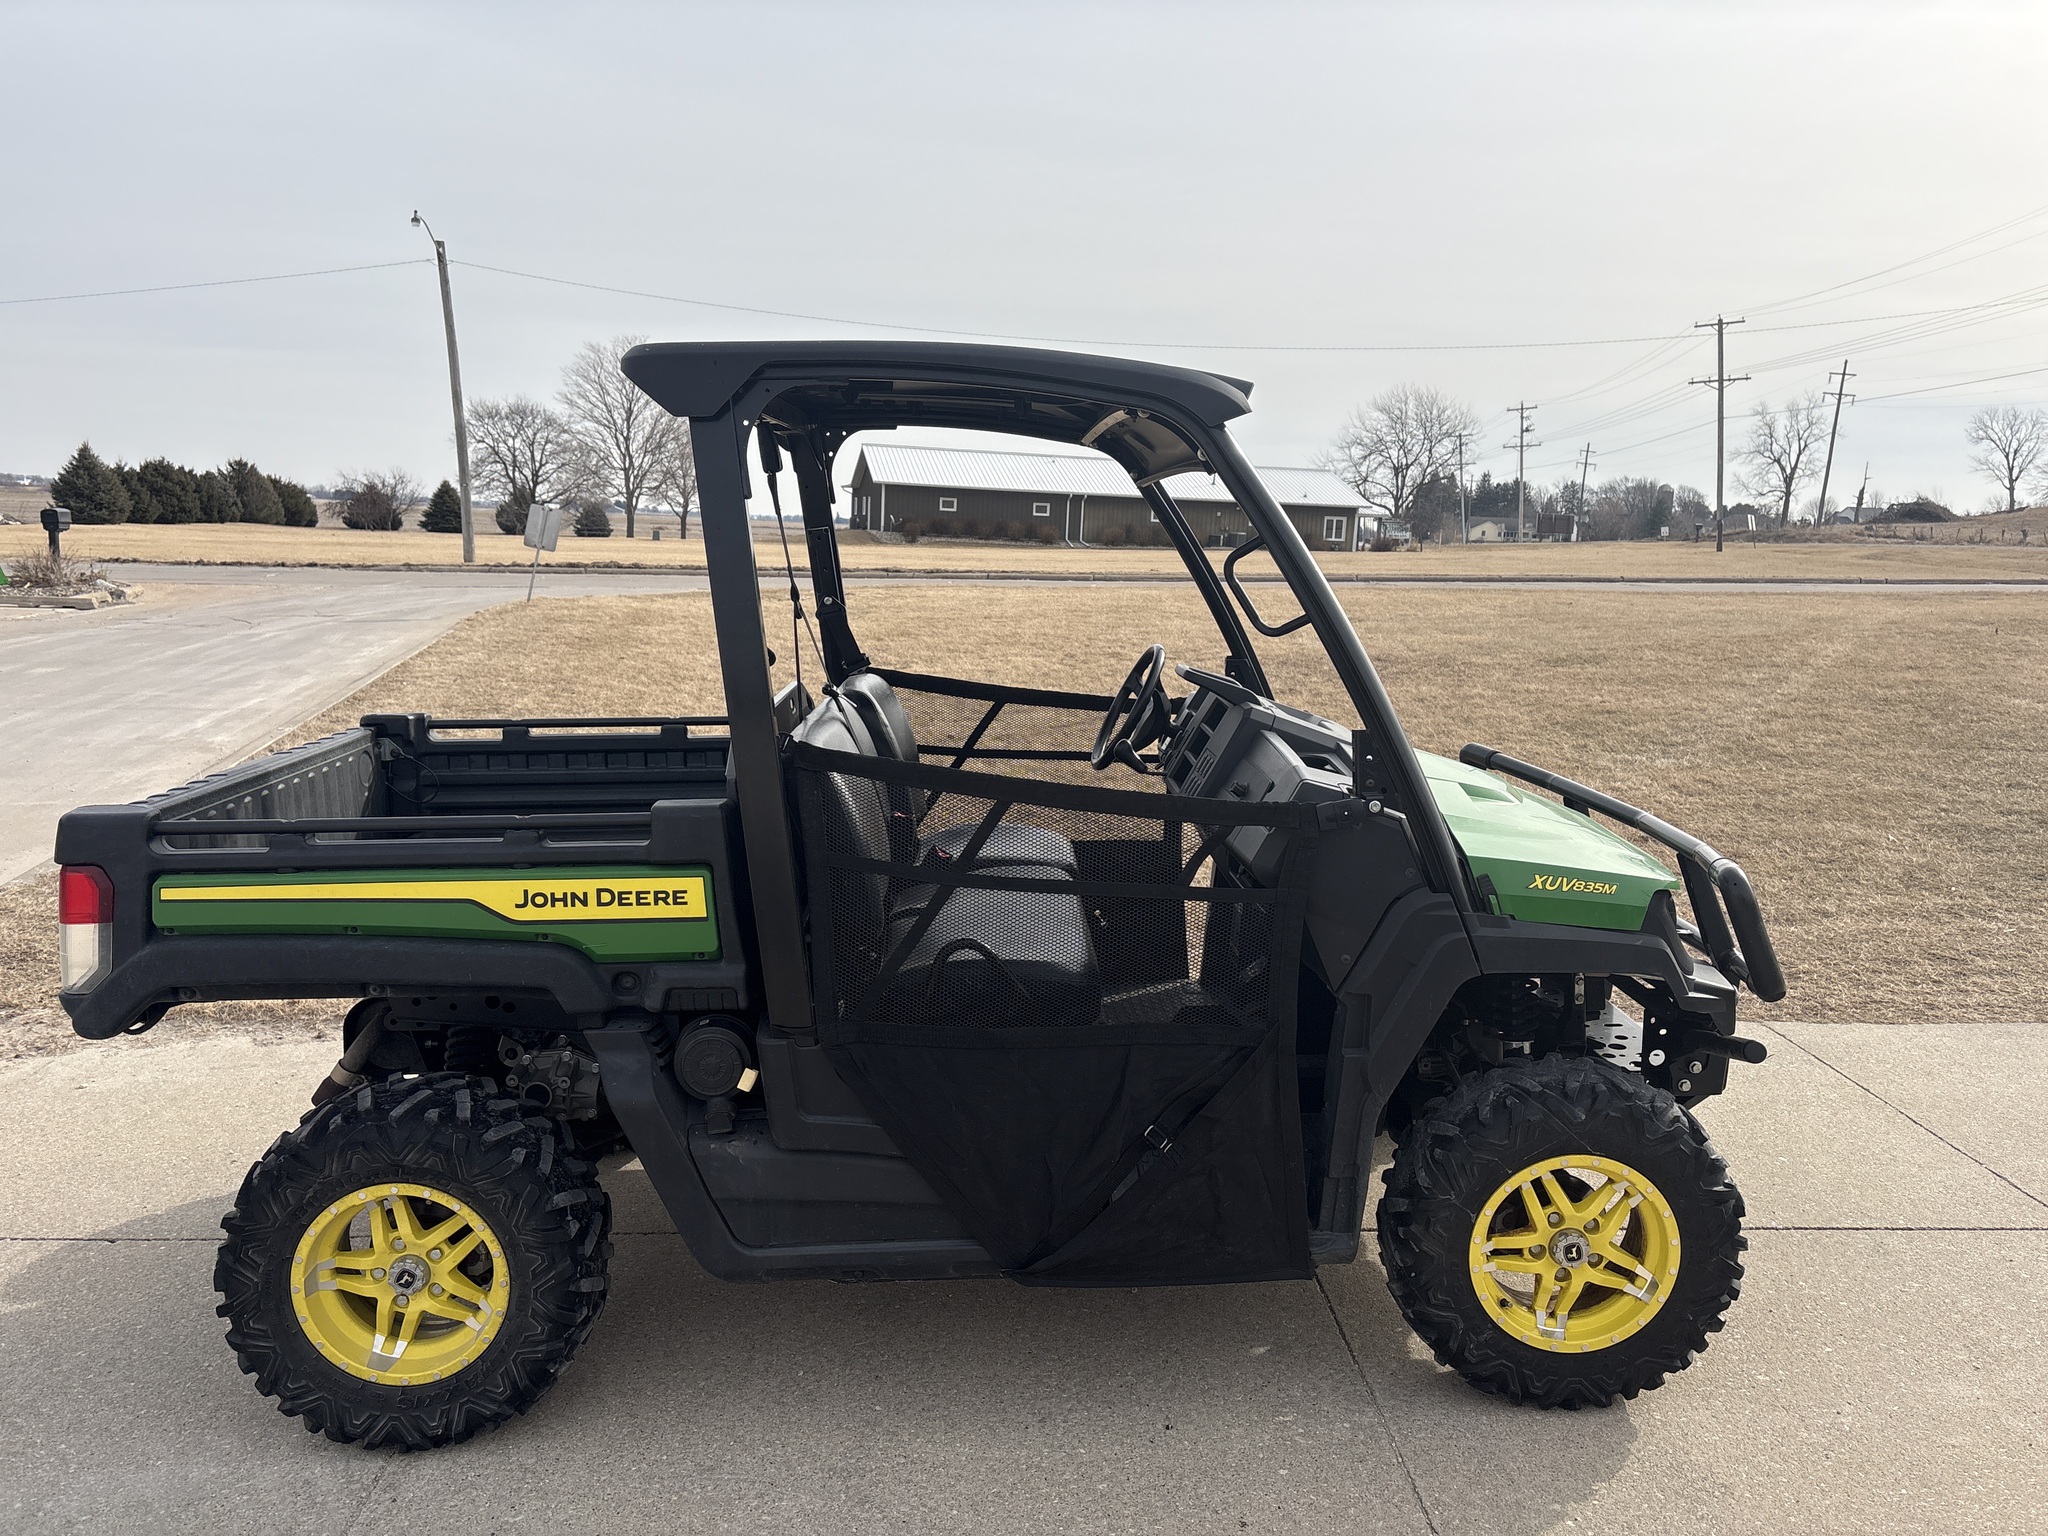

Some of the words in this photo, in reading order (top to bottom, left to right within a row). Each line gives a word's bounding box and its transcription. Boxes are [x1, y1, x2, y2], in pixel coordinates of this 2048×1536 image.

[1527, 874, 1617, 895] XUV835M
[515, 889, 588, 908] JOHN
[596, 887, 688, 907] DEERE
